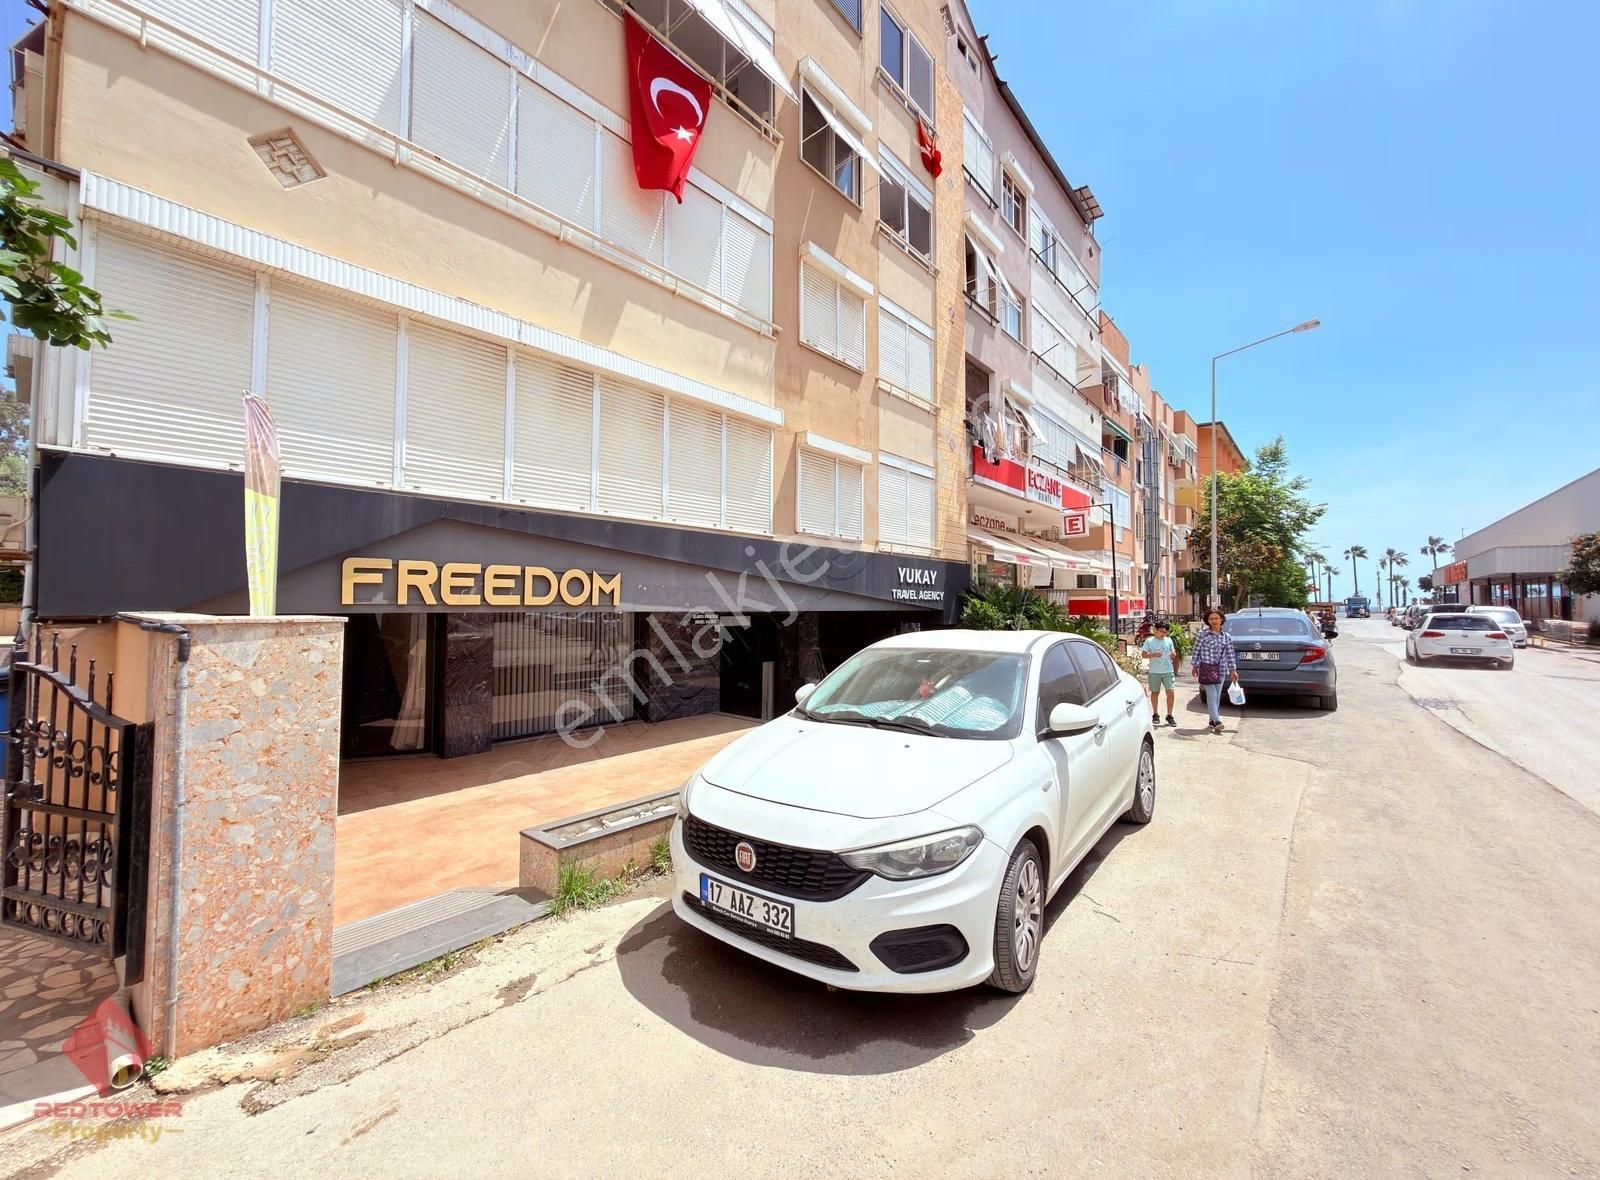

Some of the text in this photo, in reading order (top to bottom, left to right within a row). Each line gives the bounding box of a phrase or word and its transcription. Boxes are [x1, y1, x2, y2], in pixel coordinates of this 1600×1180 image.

[1068, 518, 1080, 531] E
[341, 557, 622, 606] FREEDOM
[897, 566, 938, 585] YUKAY
[892, 588, 945, 601] TRAVEL AGENCY
[709, 882, 722, 904] 17
[730, 890, 755, 918] AAZ
[762, 902, 790, 931] 332
